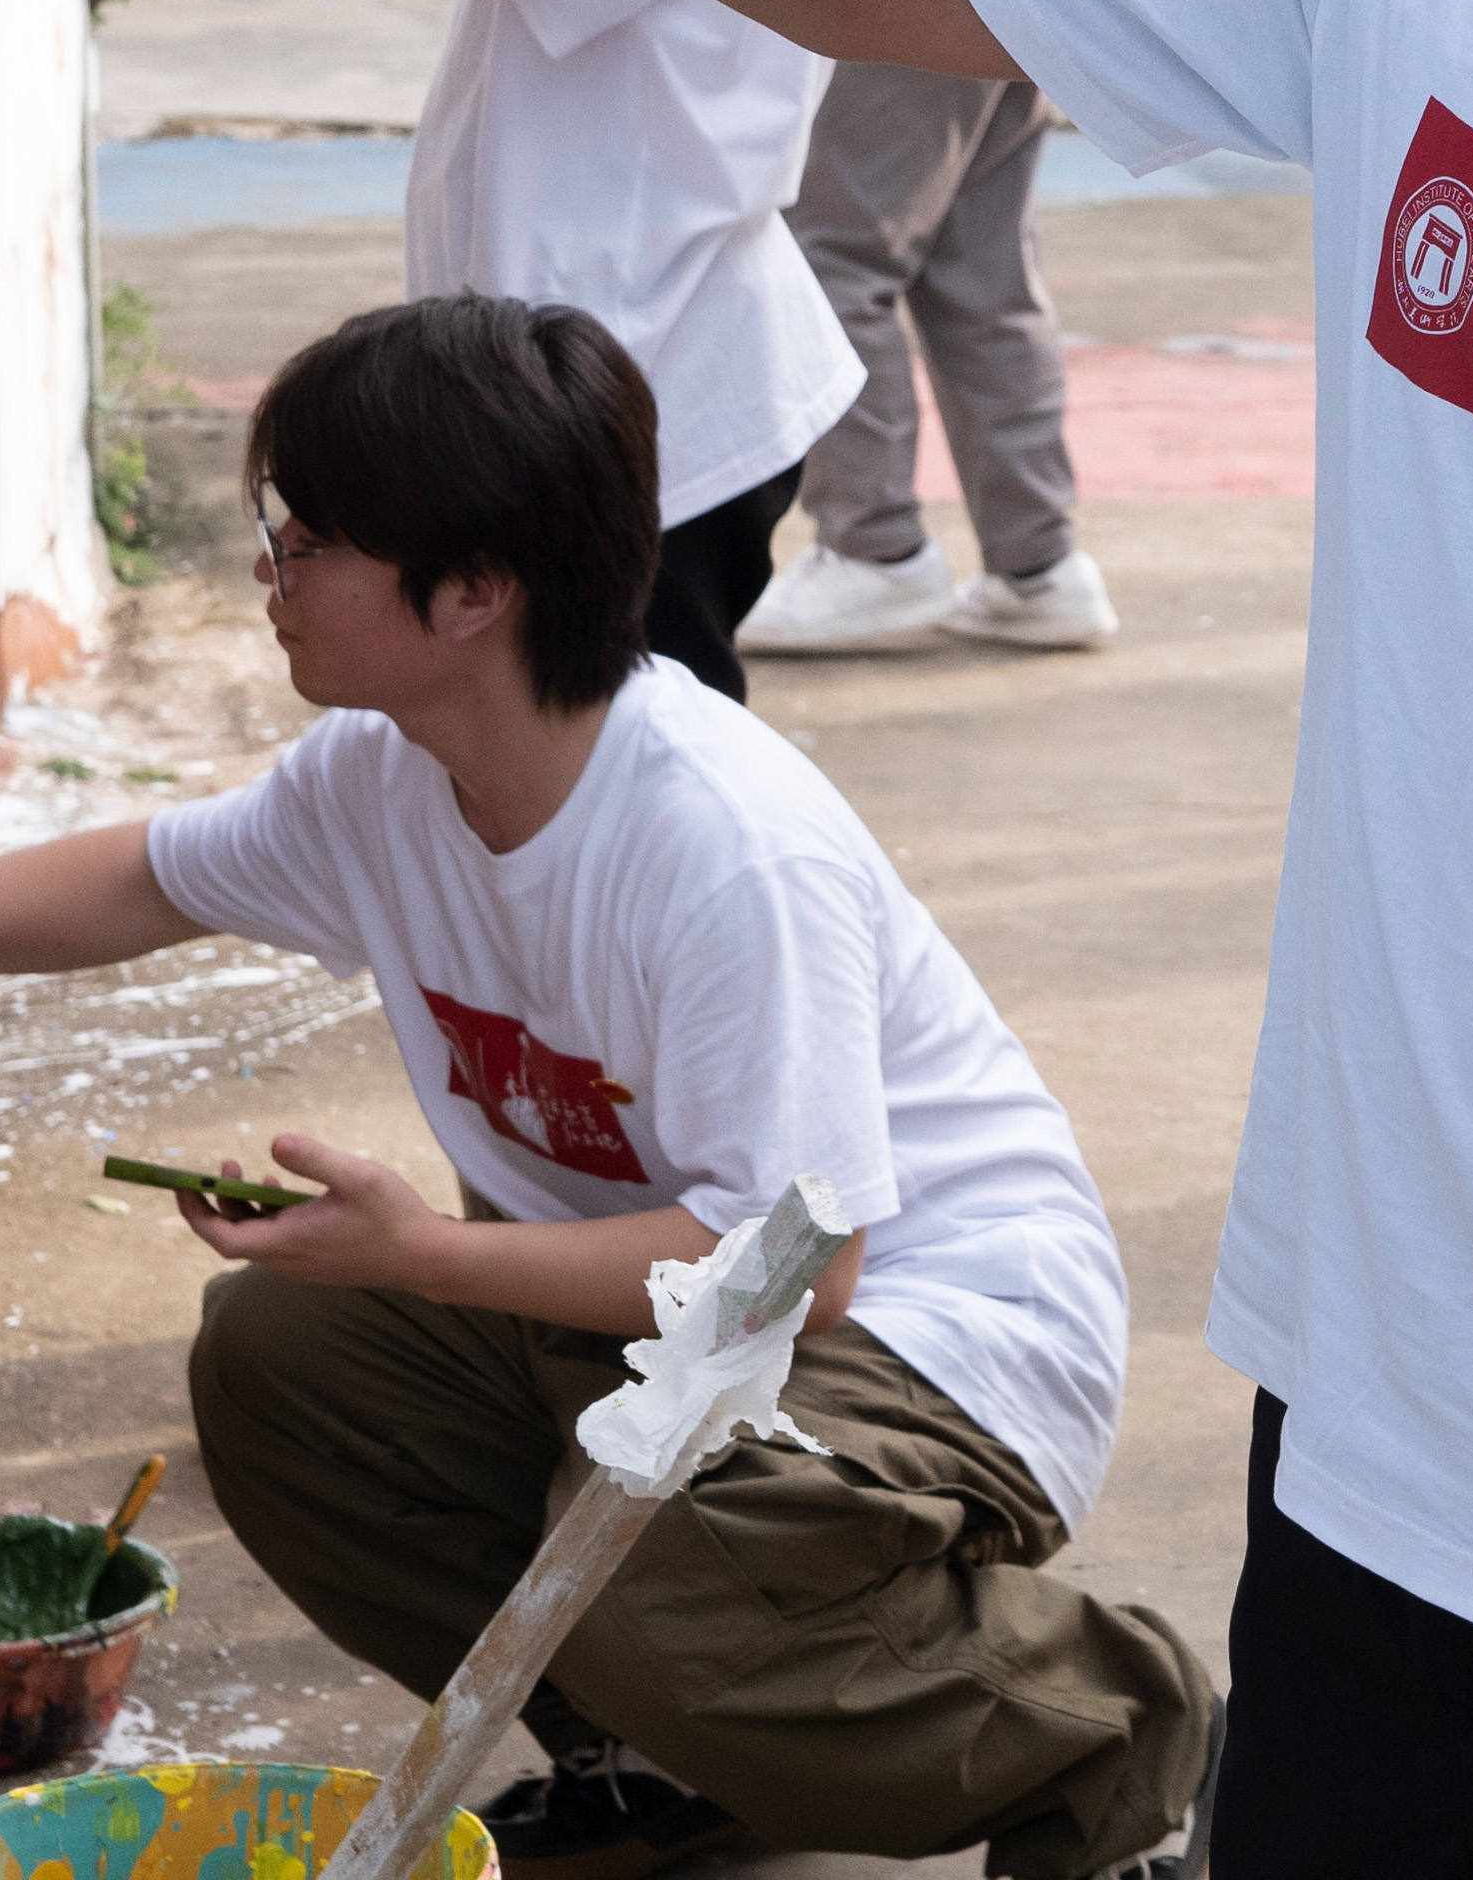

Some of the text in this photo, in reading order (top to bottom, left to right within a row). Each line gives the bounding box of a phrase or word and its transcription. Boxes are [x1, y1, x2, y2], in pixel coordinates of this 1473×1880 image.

[1396, 211, 1413, 262] HUBEI
[1412, 184, 1465, 216] INSTITUTE
[1417, 284, 1435, 299] 1920
